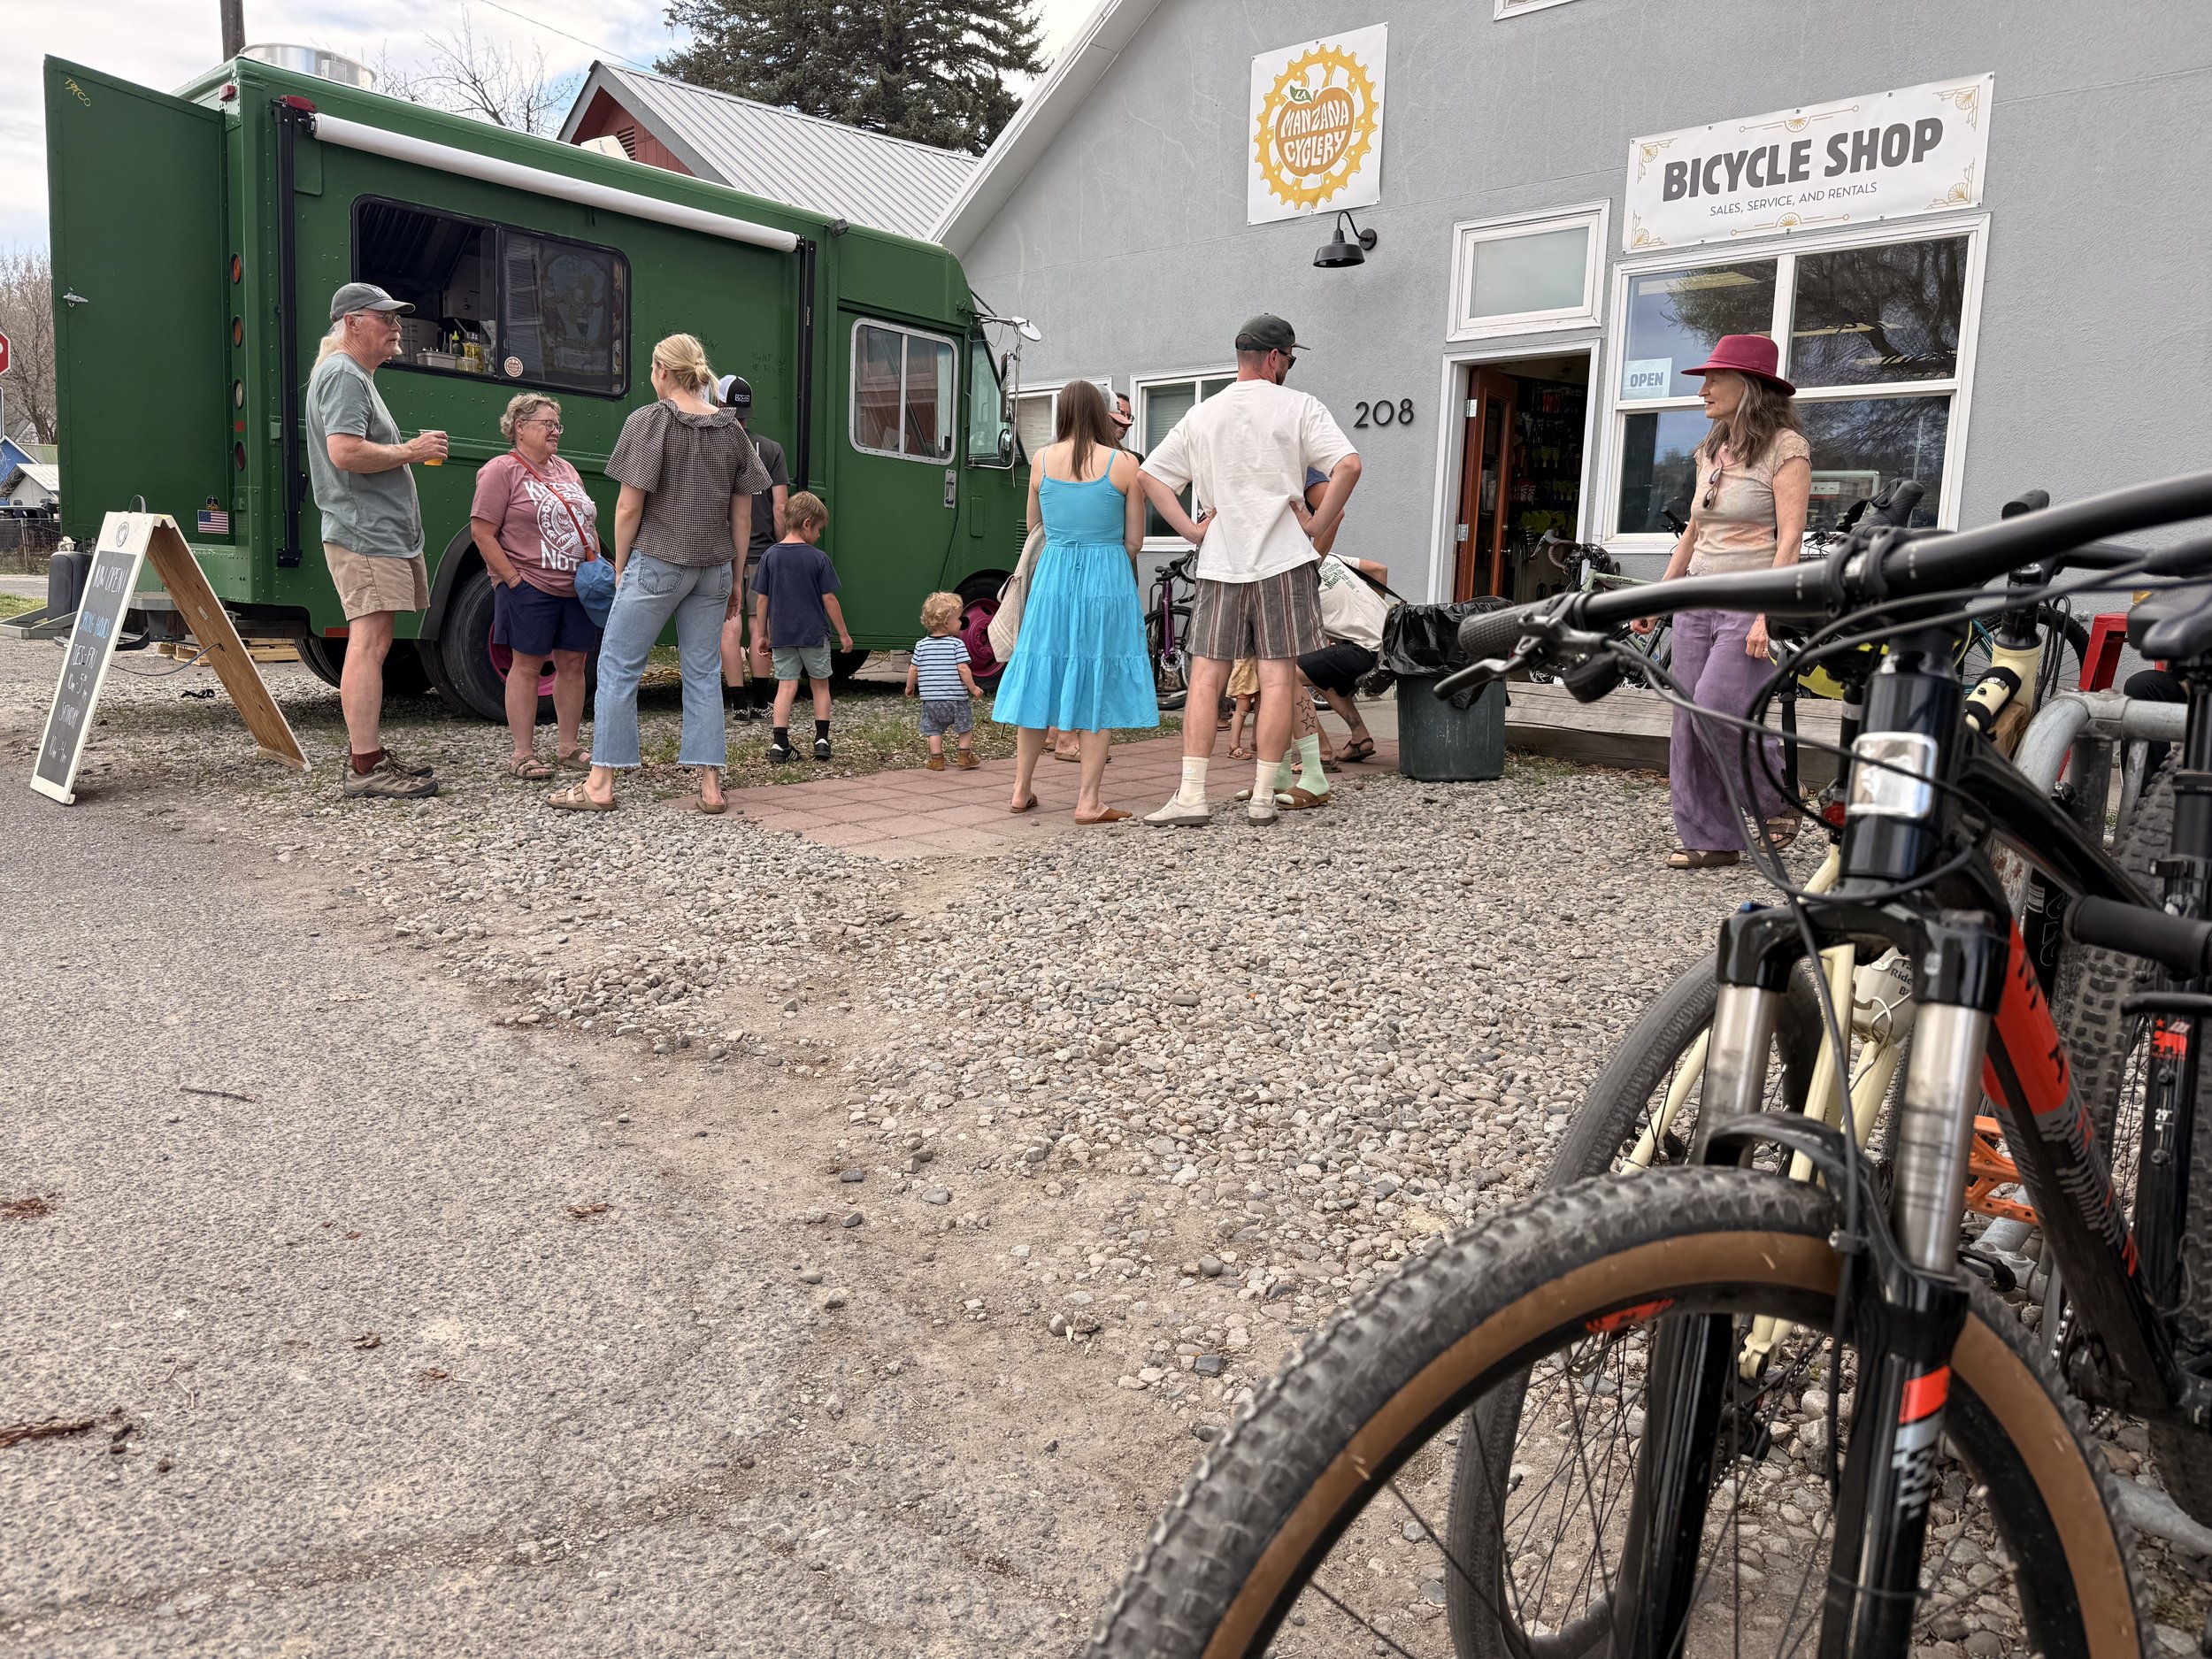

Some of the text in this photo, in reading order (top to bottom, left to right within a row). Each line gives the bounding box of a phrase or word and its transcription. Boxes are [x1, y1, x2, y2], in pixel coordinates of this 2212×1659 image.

[1294, 90, 1307, 100] LA
[1280, 99, 1349, 138] MANZANA
[1284, 130, 1347, 168] CYCLERY
[1663, 117, 1944, 202] BICYCLE SHOP
[1709, 181, 1878, 217] SALES, SERVICE, AND RENTALS
[1630, 372, 1663, 388] OPEN
[1353, 398, 1415, 428] 208
